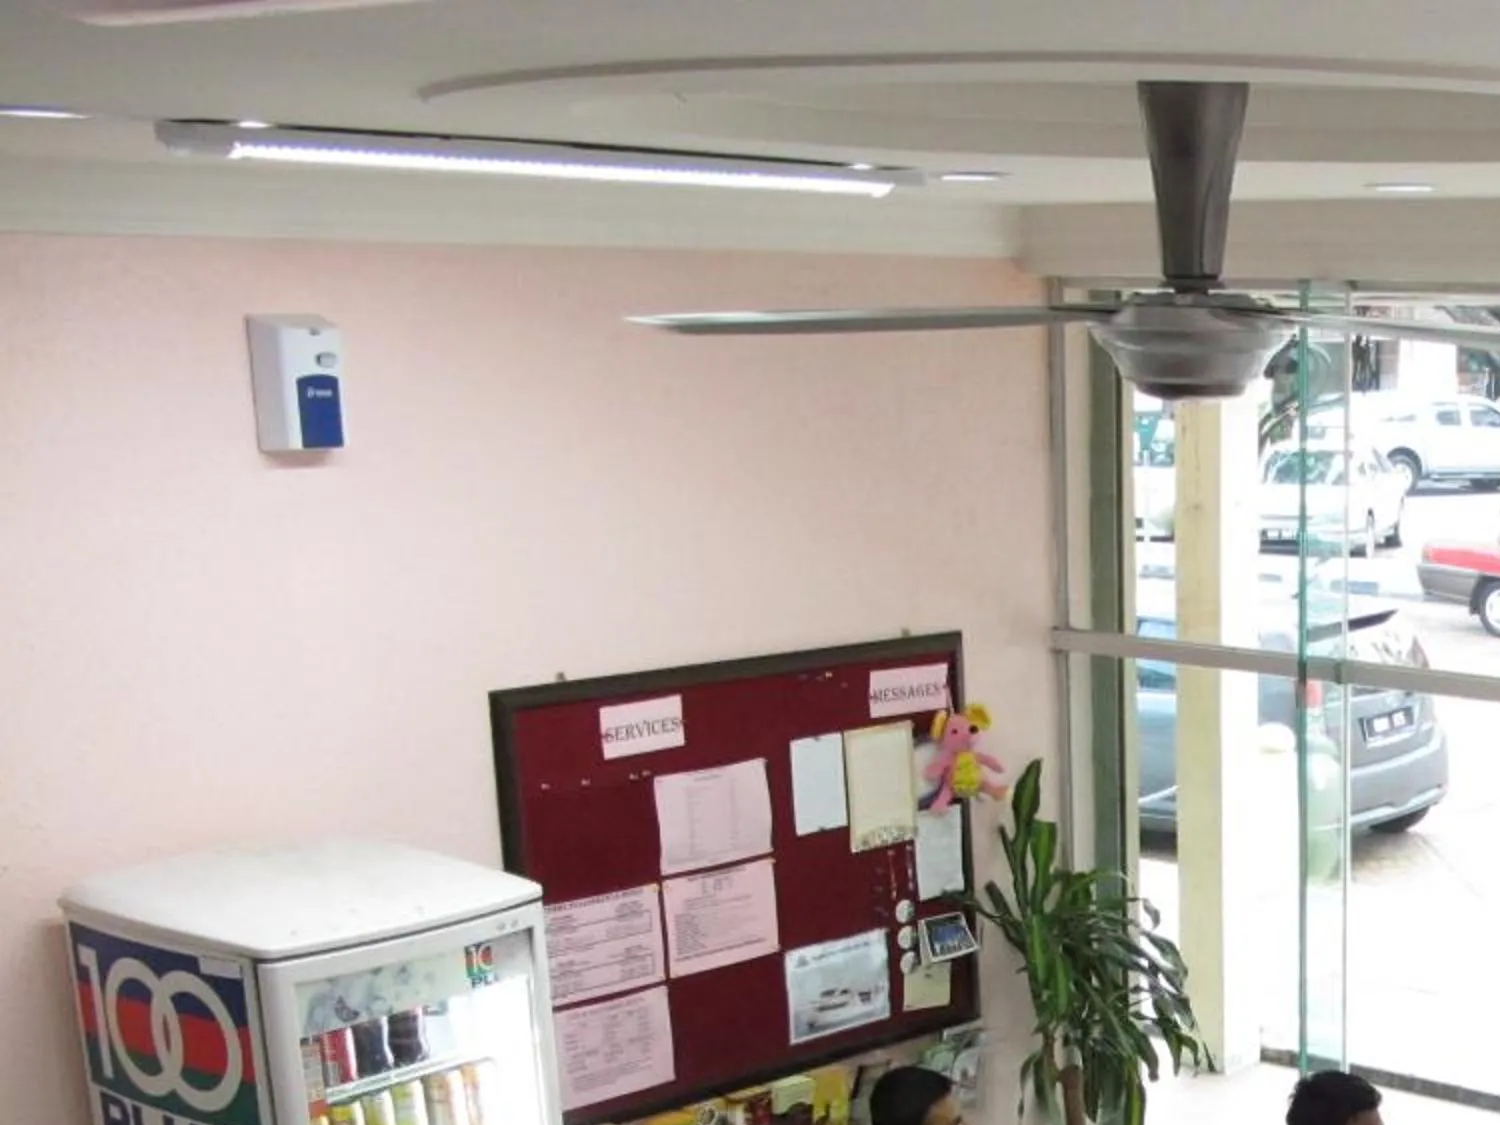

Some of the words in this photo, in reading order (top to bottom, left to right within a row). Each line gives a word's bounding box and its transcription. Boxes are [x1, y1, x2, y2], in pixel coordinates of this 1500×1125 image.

[874, 681, 942, 703] MESSAGES
[604, 718, 681, 743] SERVICES
[77, 943, 244, 1114] 100
